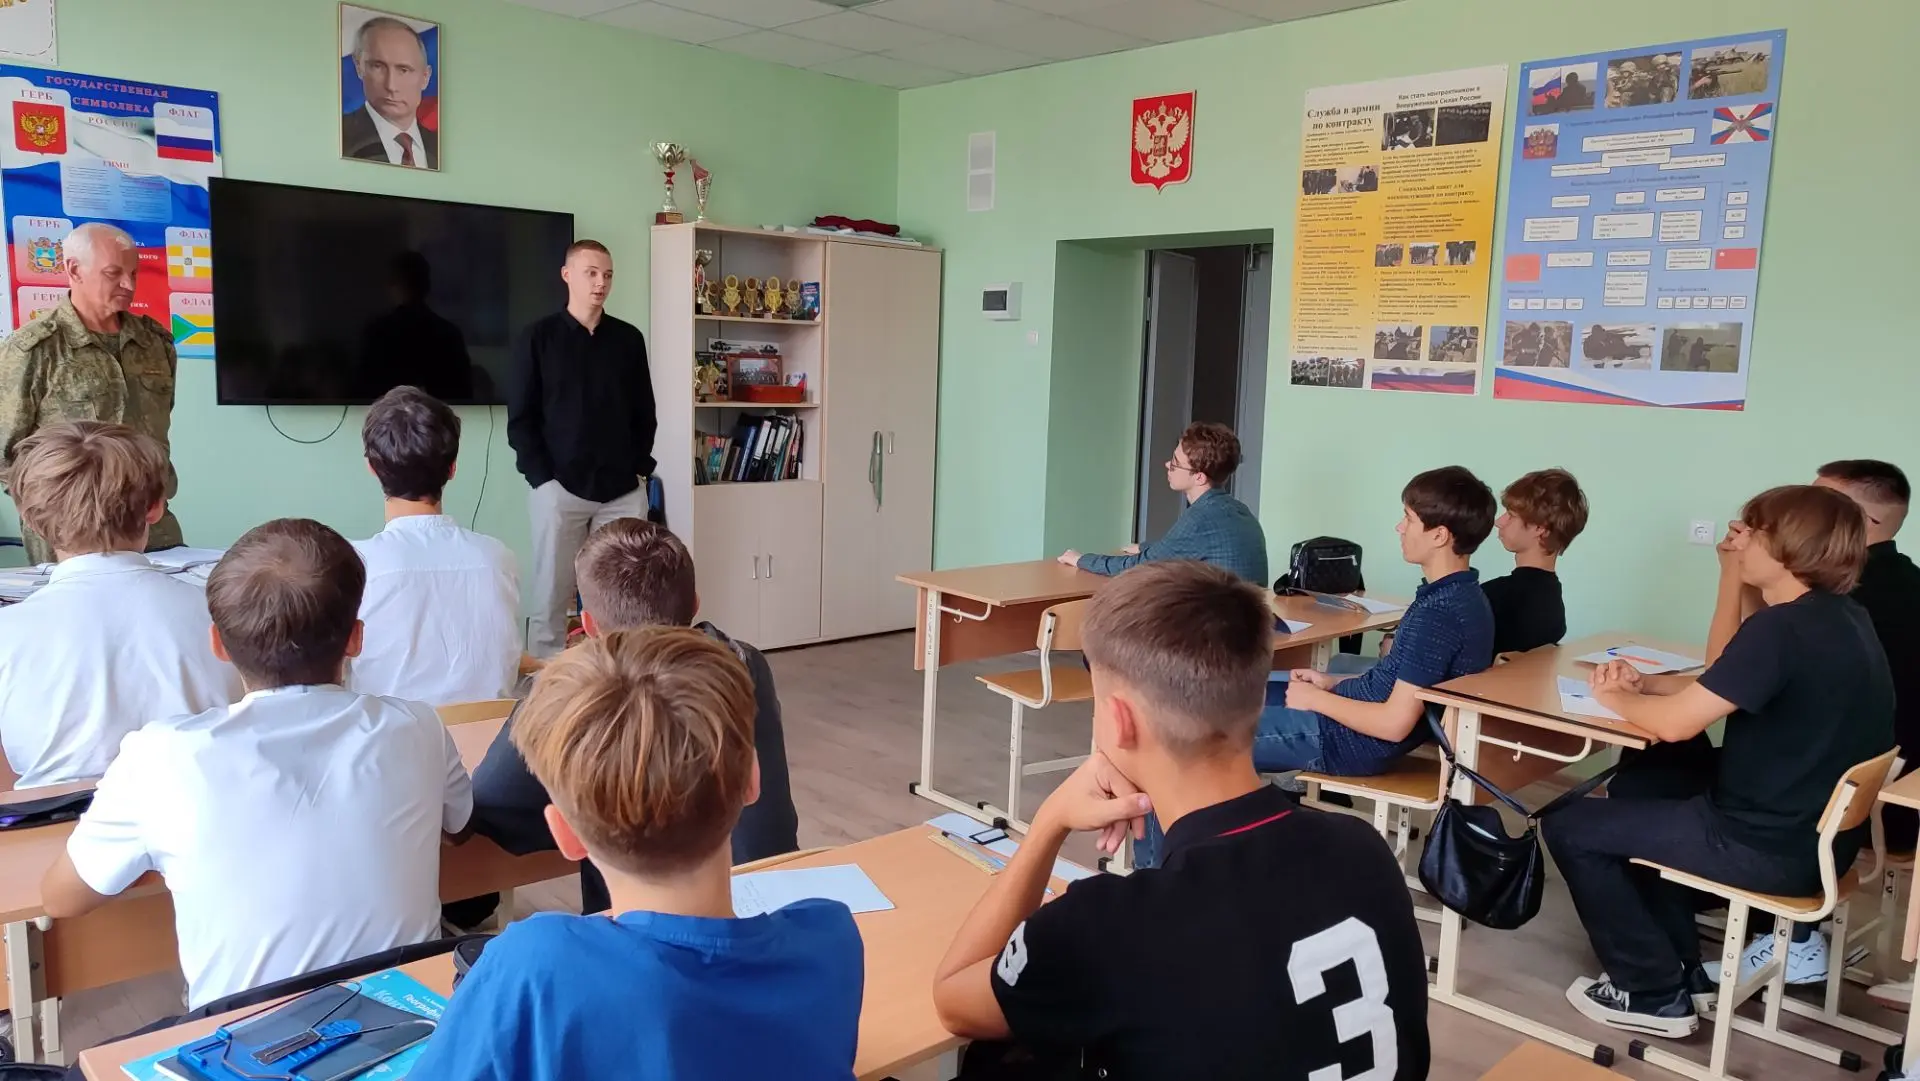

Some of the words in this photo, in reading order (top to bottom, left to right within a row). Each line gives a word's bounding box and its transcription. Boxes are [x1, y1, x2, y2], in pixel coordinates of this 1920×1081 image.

[45, 75, 169, 99] ГОСУДАРСТВЕННАЯ
[21, 89, 53, 101] ГЕРБ
[72, 96, 150, 114] СИМВОЛИКА
[1307, 107, 1341, 119] Служба
[1351, 104, 1381, 116] армии
[169, 108, 199, 118] ФЛАГ
[1312, 122, 1324, 130] по
[1325, 117, 1372, 129] контракту
[29, 219, 60, 229] ГЕРБ
[179, 230, 209, 239] ФЛАГ
[1287, 916, 1399, 1081] 3
[403, 993, 442, 1021] Географи
